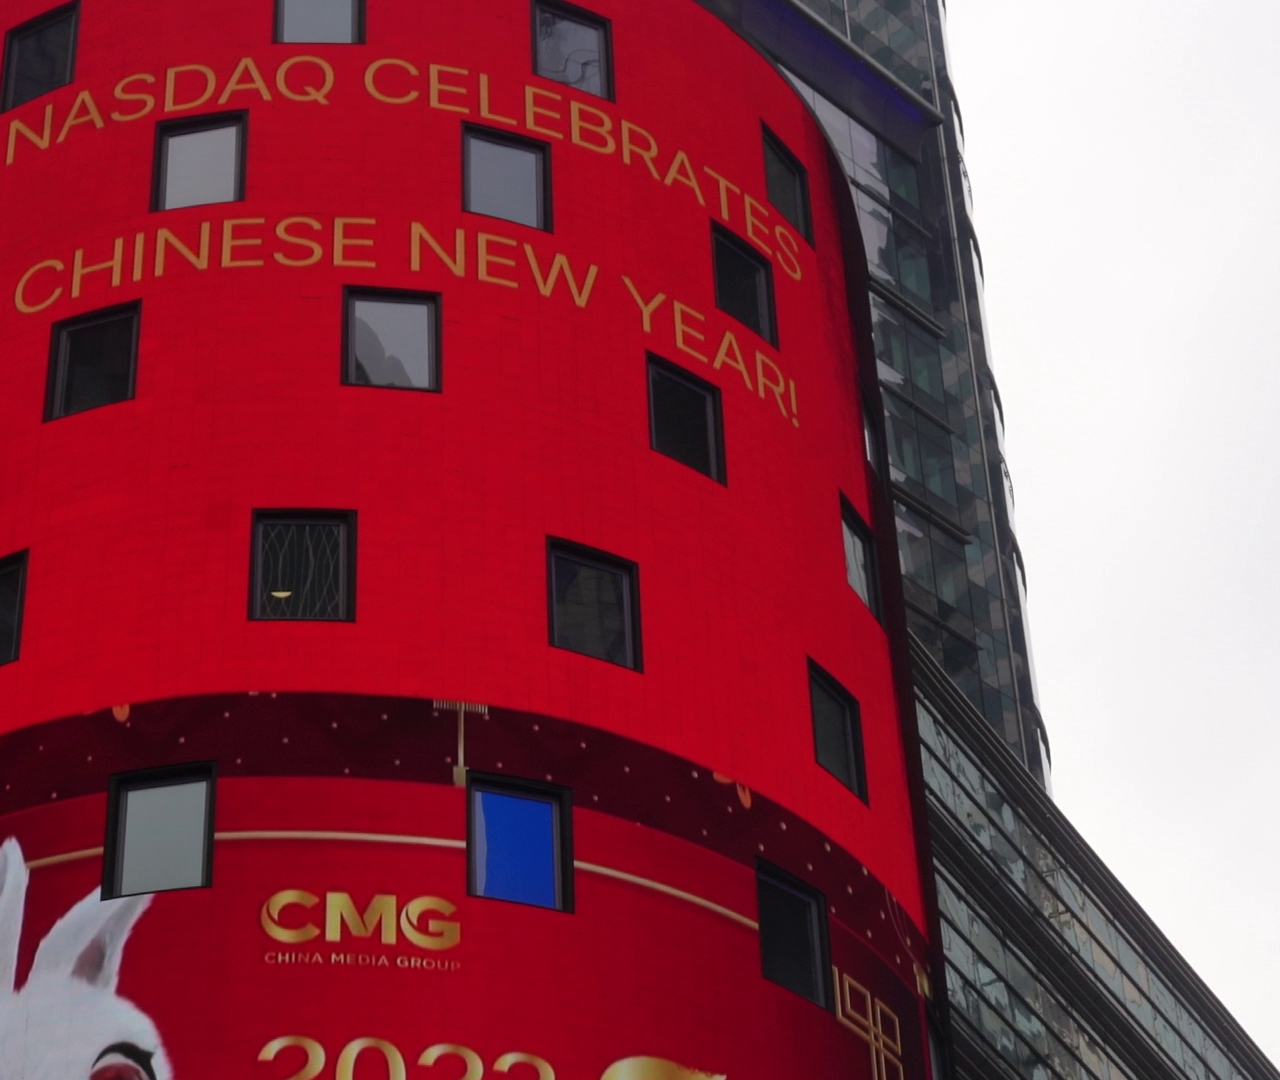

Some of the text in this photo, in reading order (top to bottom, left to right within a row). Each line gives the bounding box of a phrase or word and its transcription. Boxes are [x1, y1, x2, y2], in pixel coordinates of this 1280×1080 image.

[6, 55, 803, 283] NASDAQ CELEBRATES
[14, 216, 800, 429] CHINESE NEW YEAR!
[261, 889, 461, 951] CMG
[264, 952, 461, 972] CHINA MEDIA GROUP
